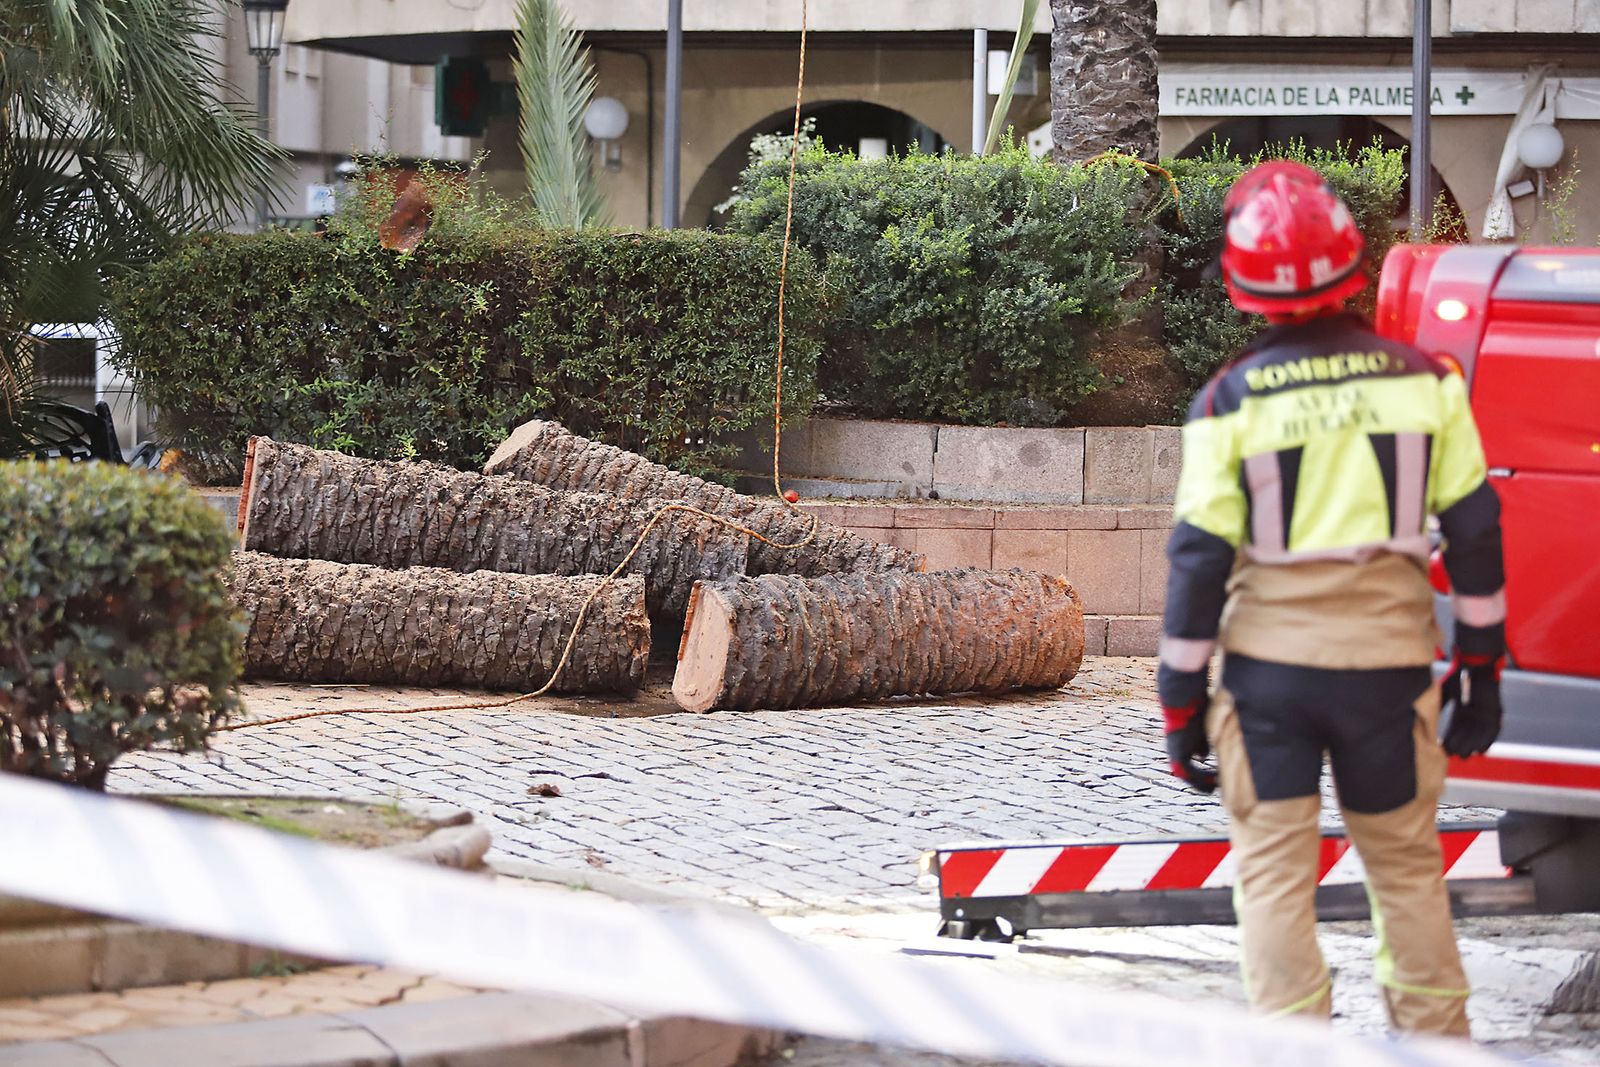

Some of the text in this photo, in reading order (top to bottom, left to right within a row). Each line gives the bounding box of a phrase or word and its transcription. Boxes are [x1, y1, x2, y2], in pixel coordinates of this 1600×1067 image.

[1175, 87, 1444, 106] FARMACIA DE LA PALMEA
